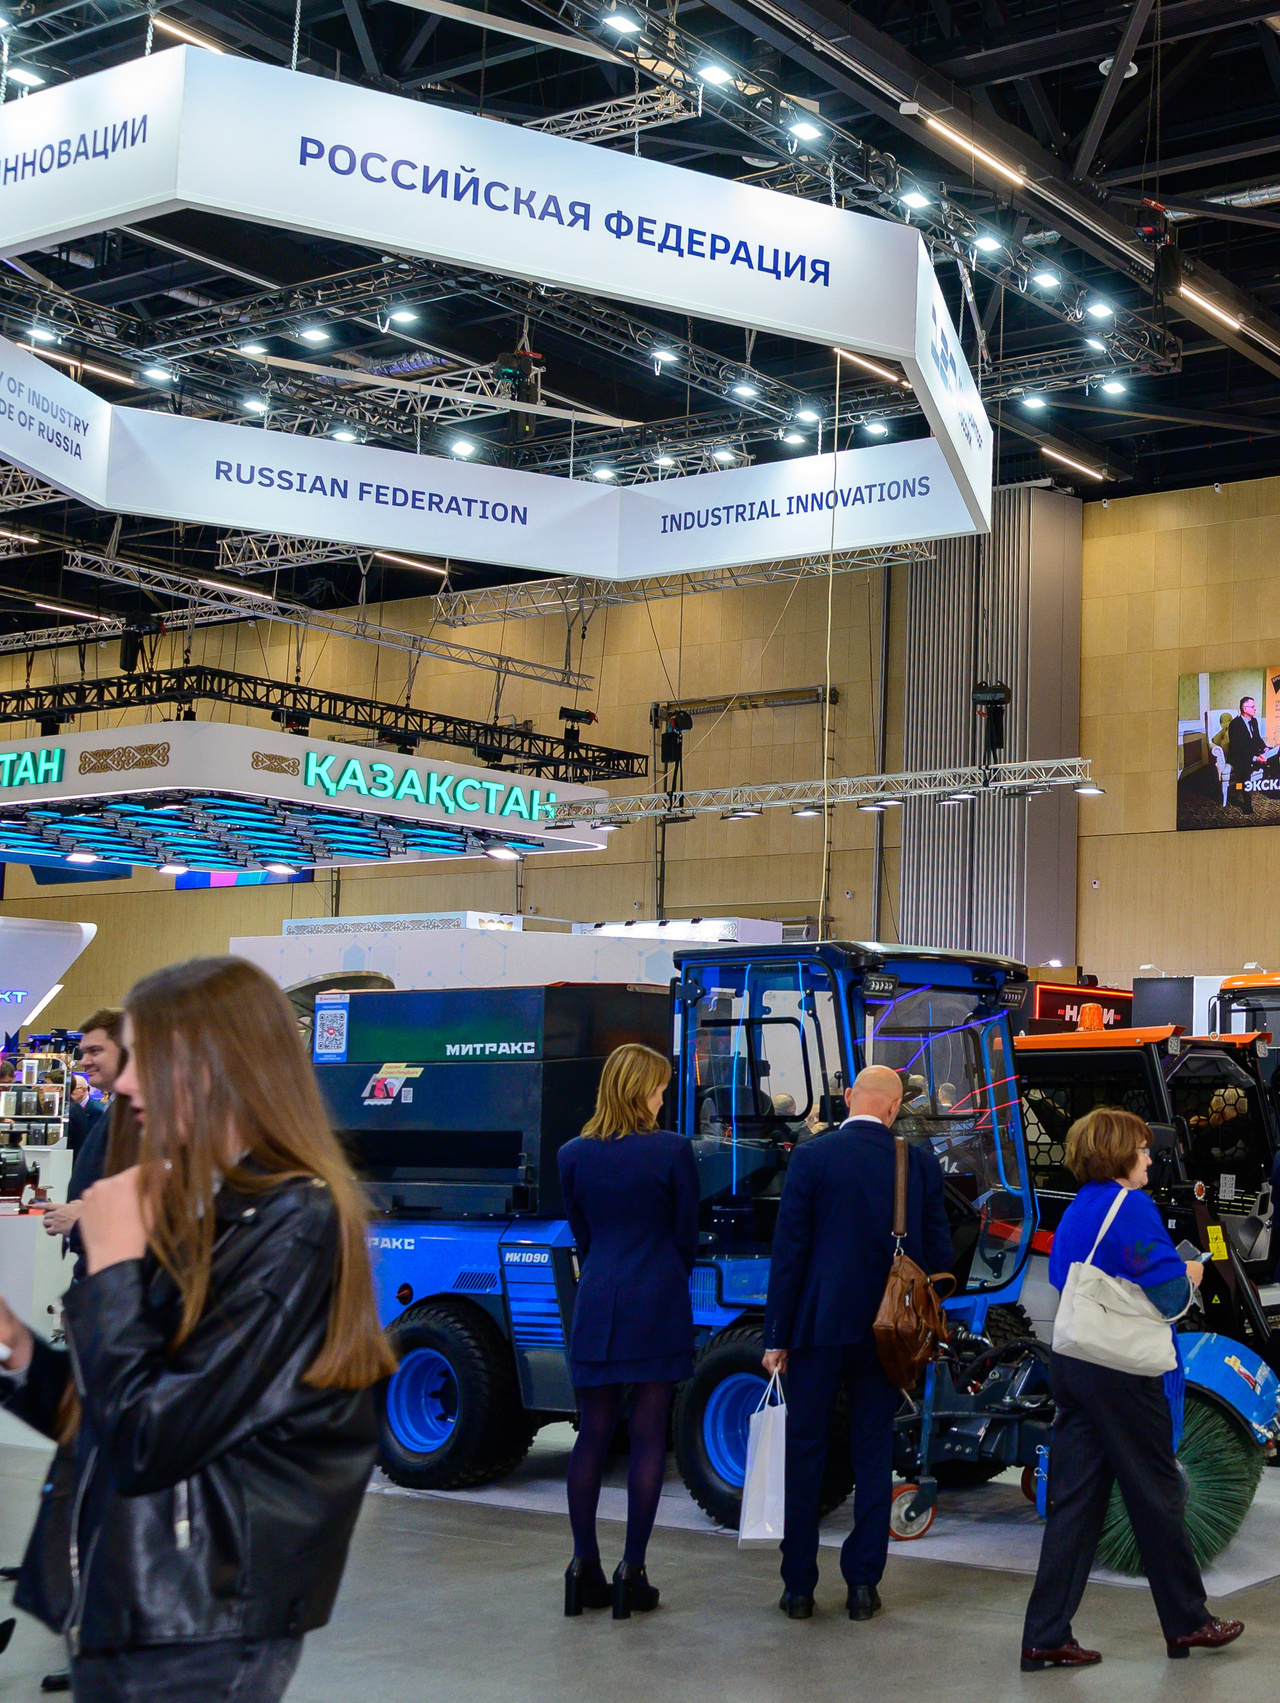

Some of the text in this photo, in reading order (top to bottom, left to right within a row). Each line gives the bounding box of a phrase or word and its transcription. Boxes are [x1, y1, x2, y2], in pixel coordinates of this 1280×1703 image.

[0, 114, 148, 186] ННОВАЦИИ
[299, 135, 831, 287] РОССИЙСКАЯ ФЕДЕРАЦИЯ
[7, 376, 90, 437] OF INDUSTRY
[18, 410, 36, 432] OF
[38, 420, 82, 460] RUSSIA
[215, 459, 529, 526] RUSSIAN FEDERATION
[660, 475, 931, 534] INDUSTRIAL INNOVATIONS
[0, 747, 65, 787] ТАН
[304, 751, 557, 821] ҚАЗАҚСТАН
[445, 1041, 536, 1056] МИТРАКС
